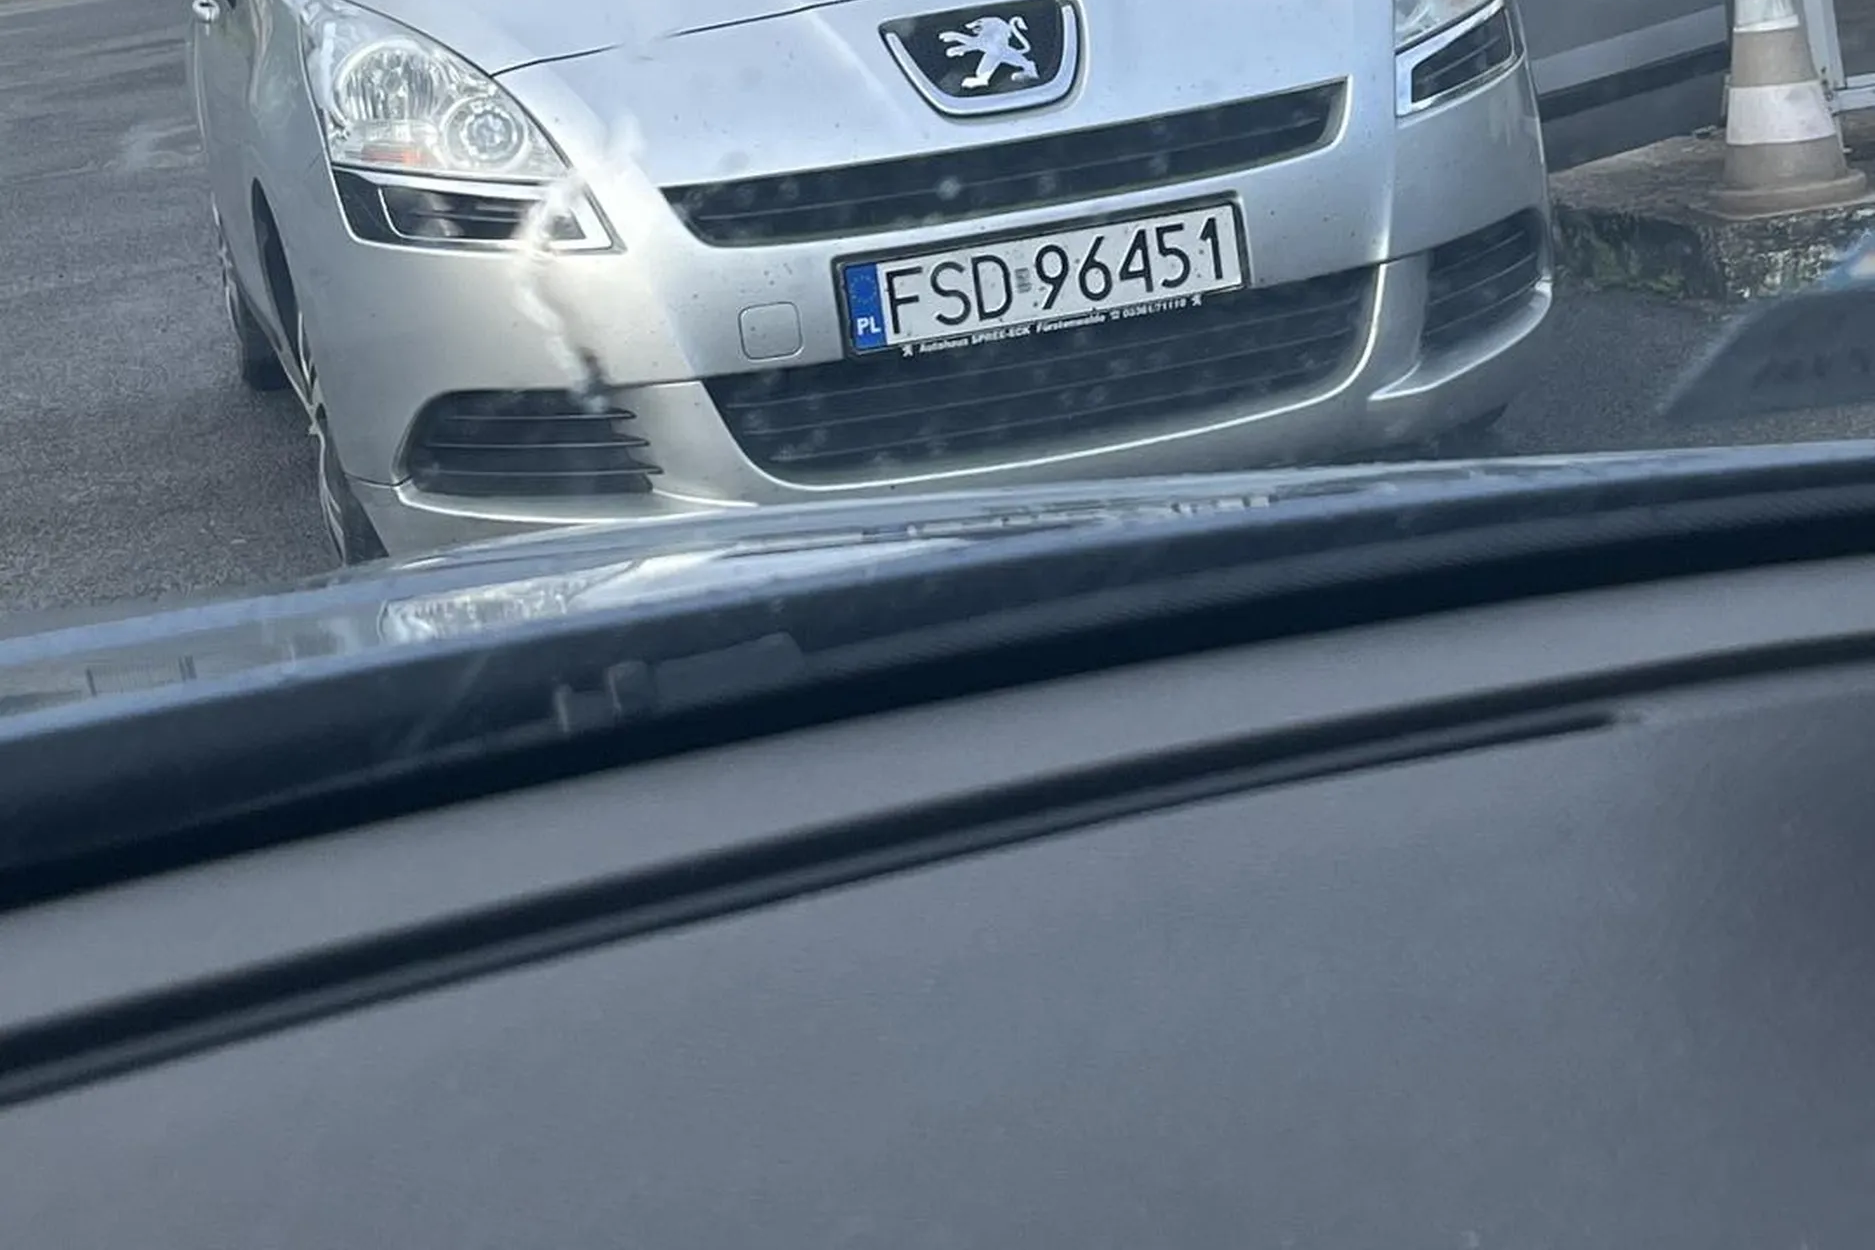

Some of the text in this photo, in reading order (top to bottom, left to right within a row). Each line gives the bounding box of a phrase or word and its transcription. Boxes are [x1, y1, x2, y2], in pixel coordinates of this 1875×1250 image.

[885, 216, 1224, 335] FSD 96451
[856, 316, 882, 336] PL
[919, 336, 969, 353] Autohaus
